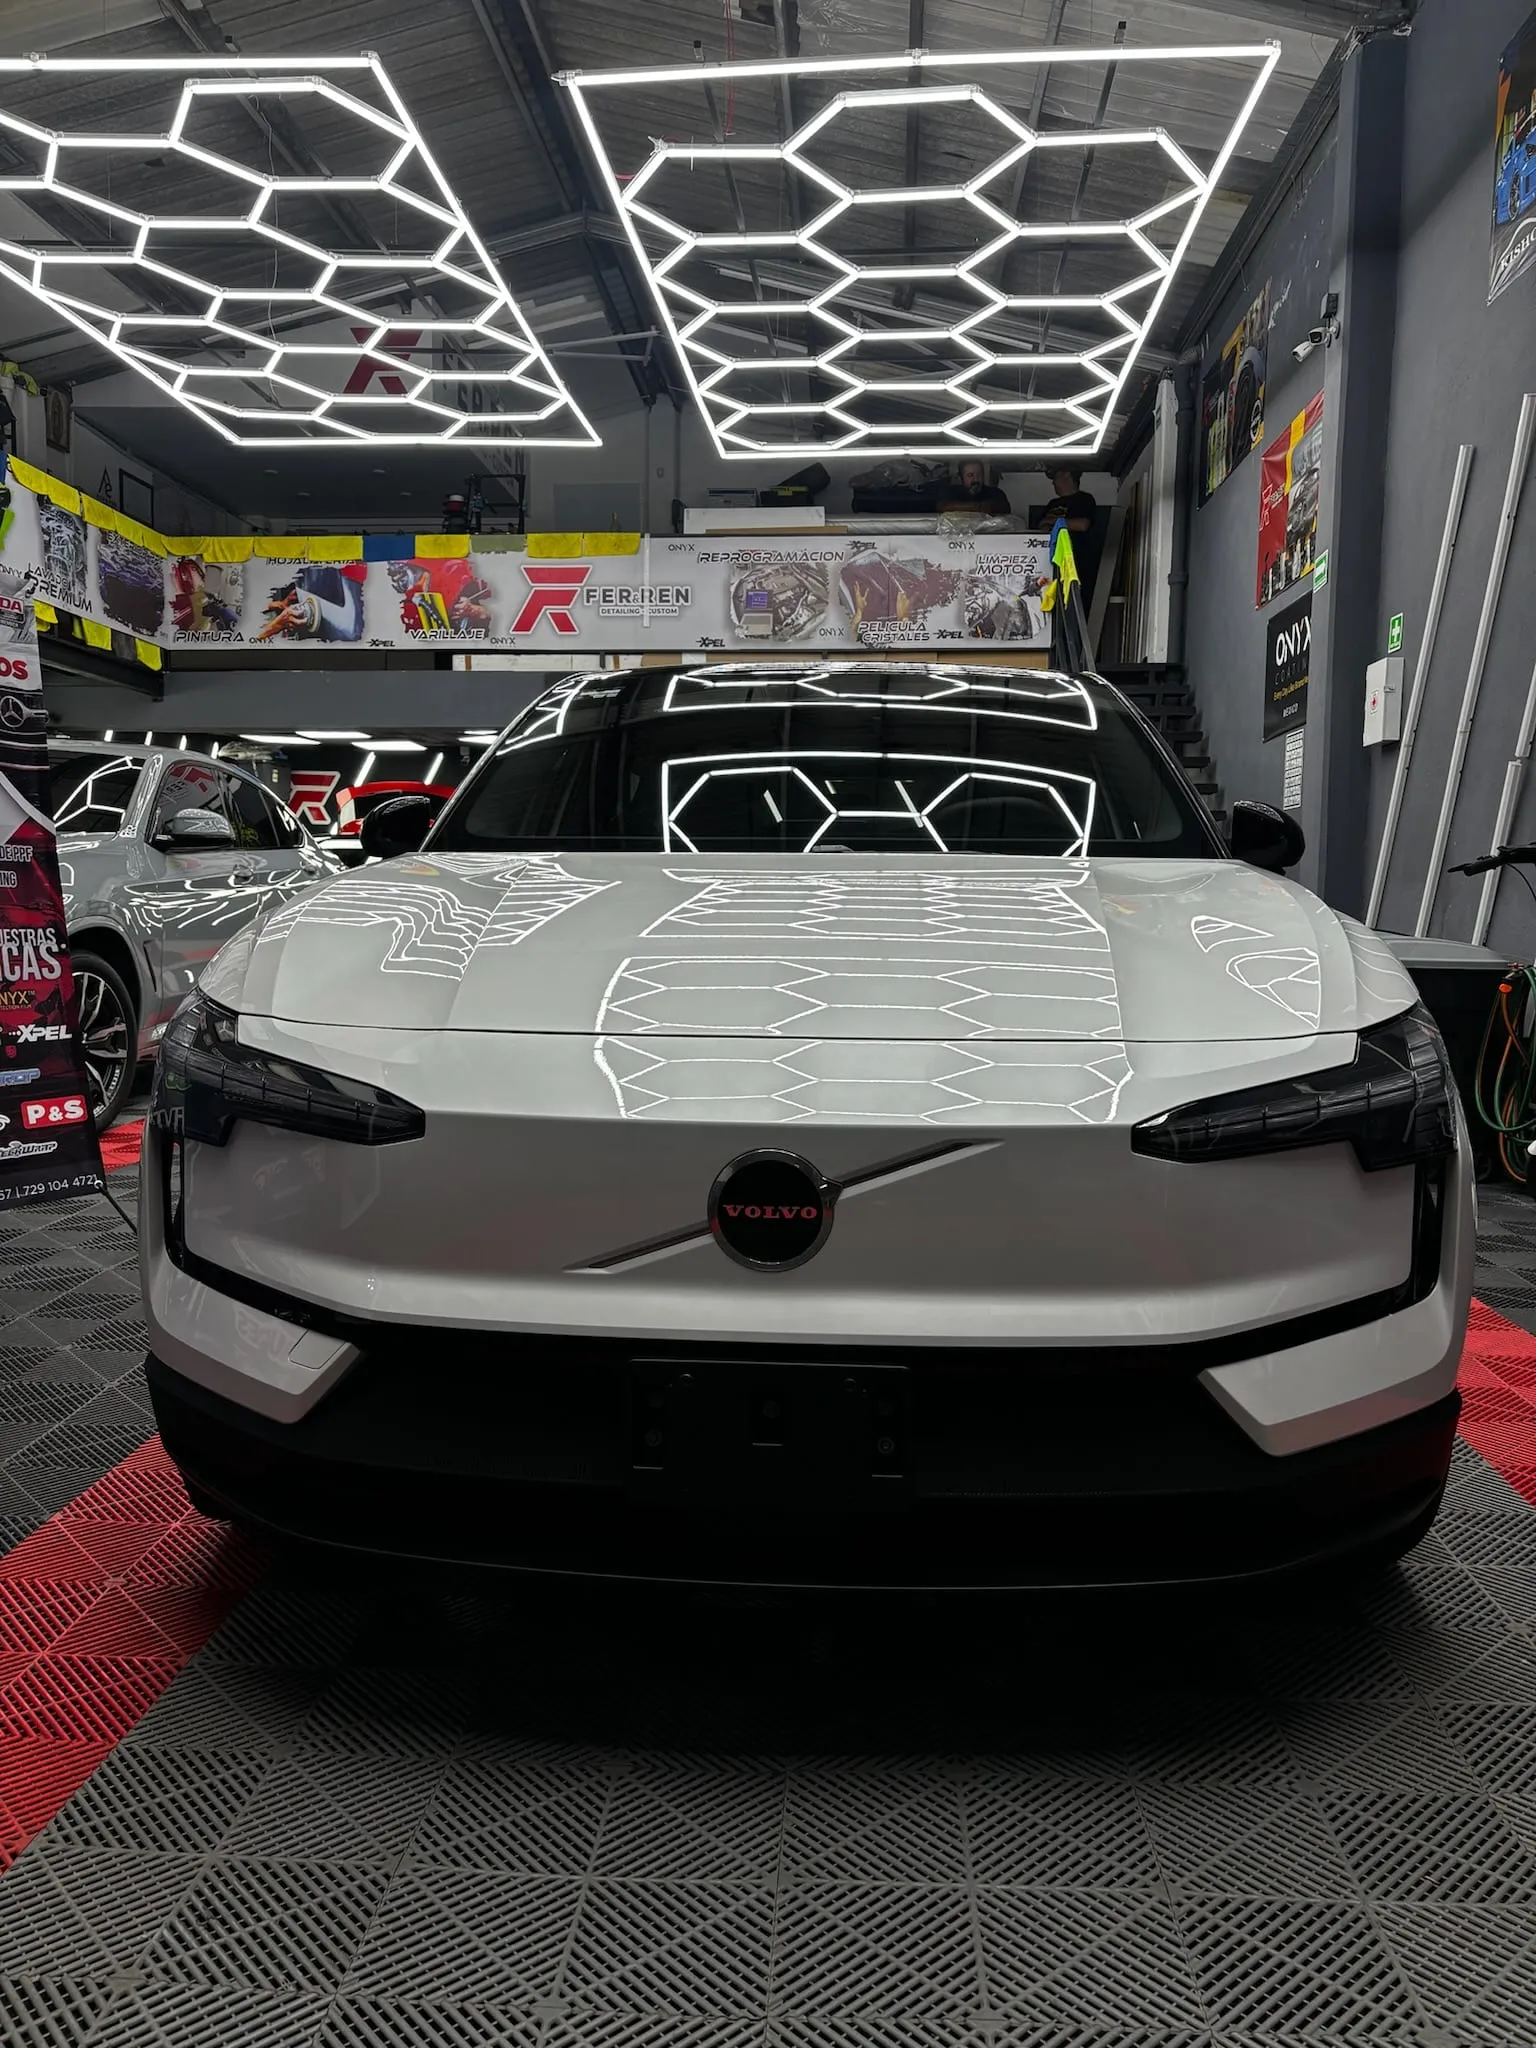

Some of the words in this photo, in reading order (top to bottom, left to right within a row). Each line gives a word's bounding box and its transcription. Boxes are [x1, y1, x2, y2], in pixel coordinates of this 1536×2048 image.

[668, 544, 695, 552] ONYX
[846, 541, 877, 550] XPEL
[699, 551, 844, 562] REPROGRAMACION
[977, 555, 1038, 565] LIMPIEZA
[976, 564, 1037, 575] MOTOR
[601, 607, 640, 615] DETAILING
[860, 622, 927, 632] PELICULA
[175, 631, 245, 643] PINTURA
[409, 629, 484, 641] VARILLAJE
[862, 632, 930, 642] CRISTALES
[933, 629, 964, 639] XPEL
[366, 639, 396, 647] XPEL
[490, 637, 516, 645] ONYX
[696, 637, 726, 648] XPEL
[17, 1024, 72, 1044] XPEL
[26, 1100, 84, 1125] P&S
[22, 1184, 46, 1197] 729
[47, 1180, 69, 1192] 104
[723, 1204, 818, 1219] VOLVO
